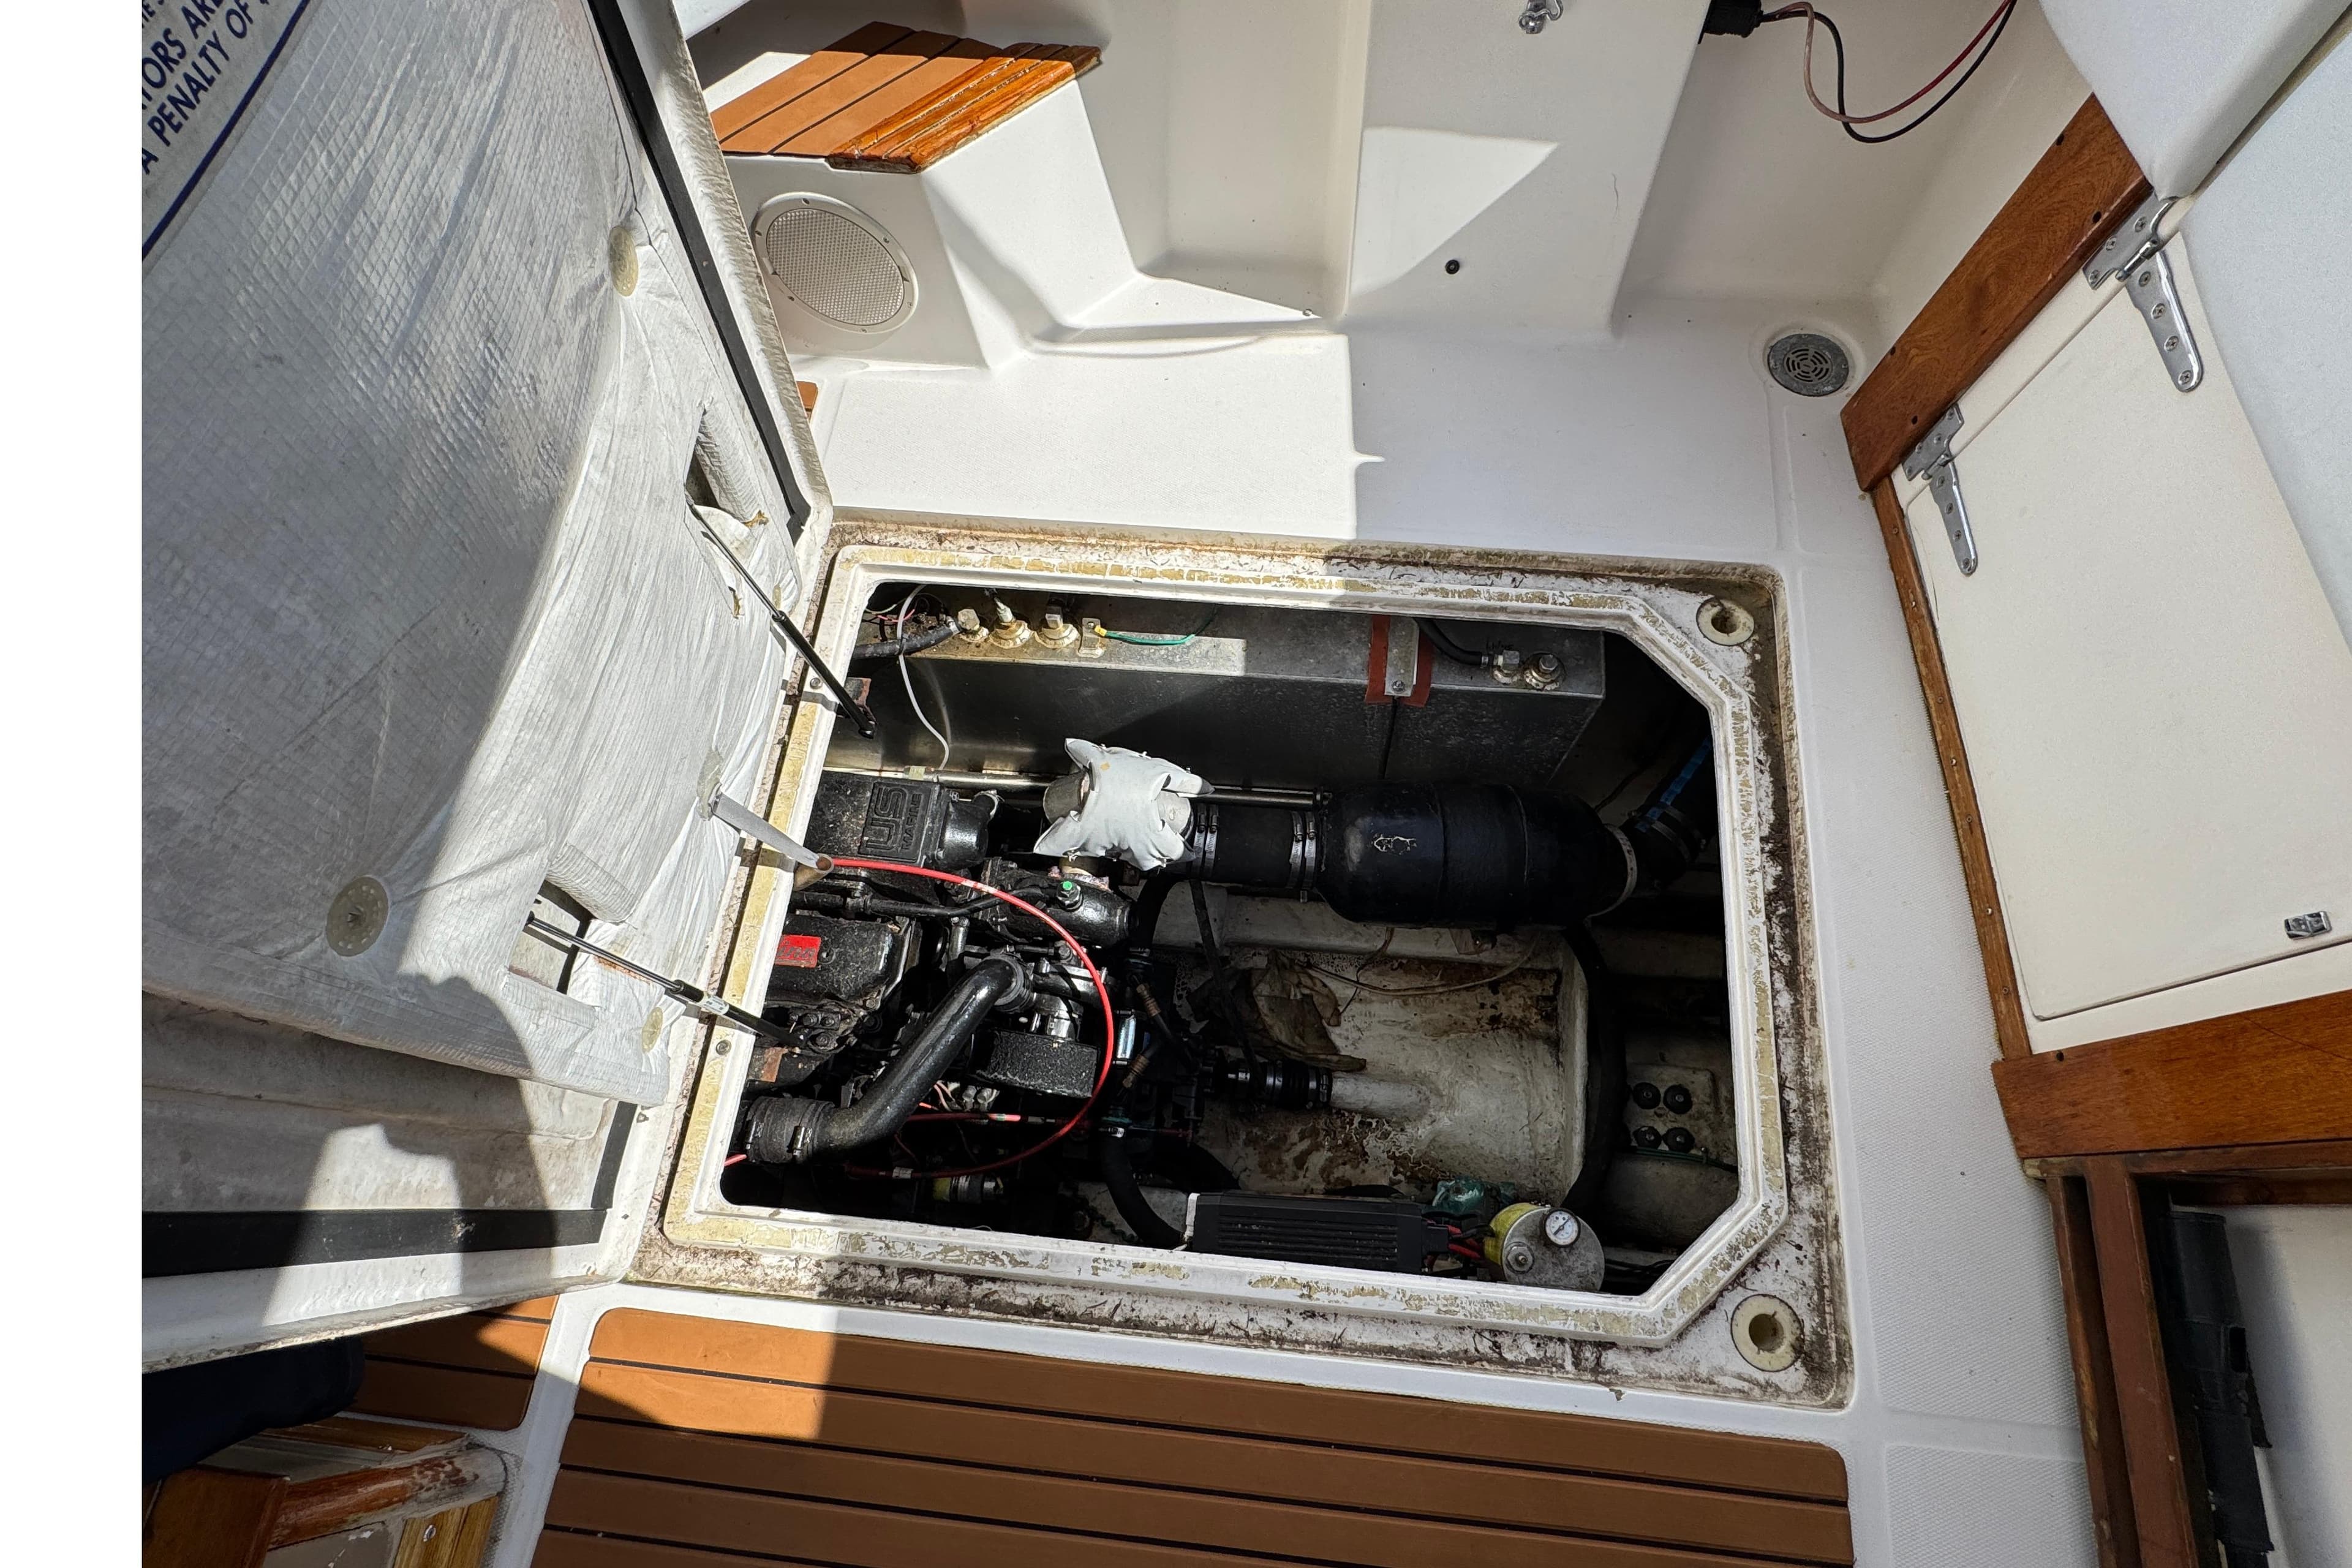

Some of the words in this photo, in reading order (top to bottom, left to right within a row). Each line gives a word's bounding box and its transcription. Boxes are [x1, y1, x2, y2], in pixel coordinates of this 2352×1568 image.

[182, 0, 224, 39] AR
[225, 0, 253, 39] OF
[148, 30, 230, 146] PENALTY
[142, 147, 159, 175] A
[865, 786, 907, 850] US
[901, 793, 922, 850] MARINE
